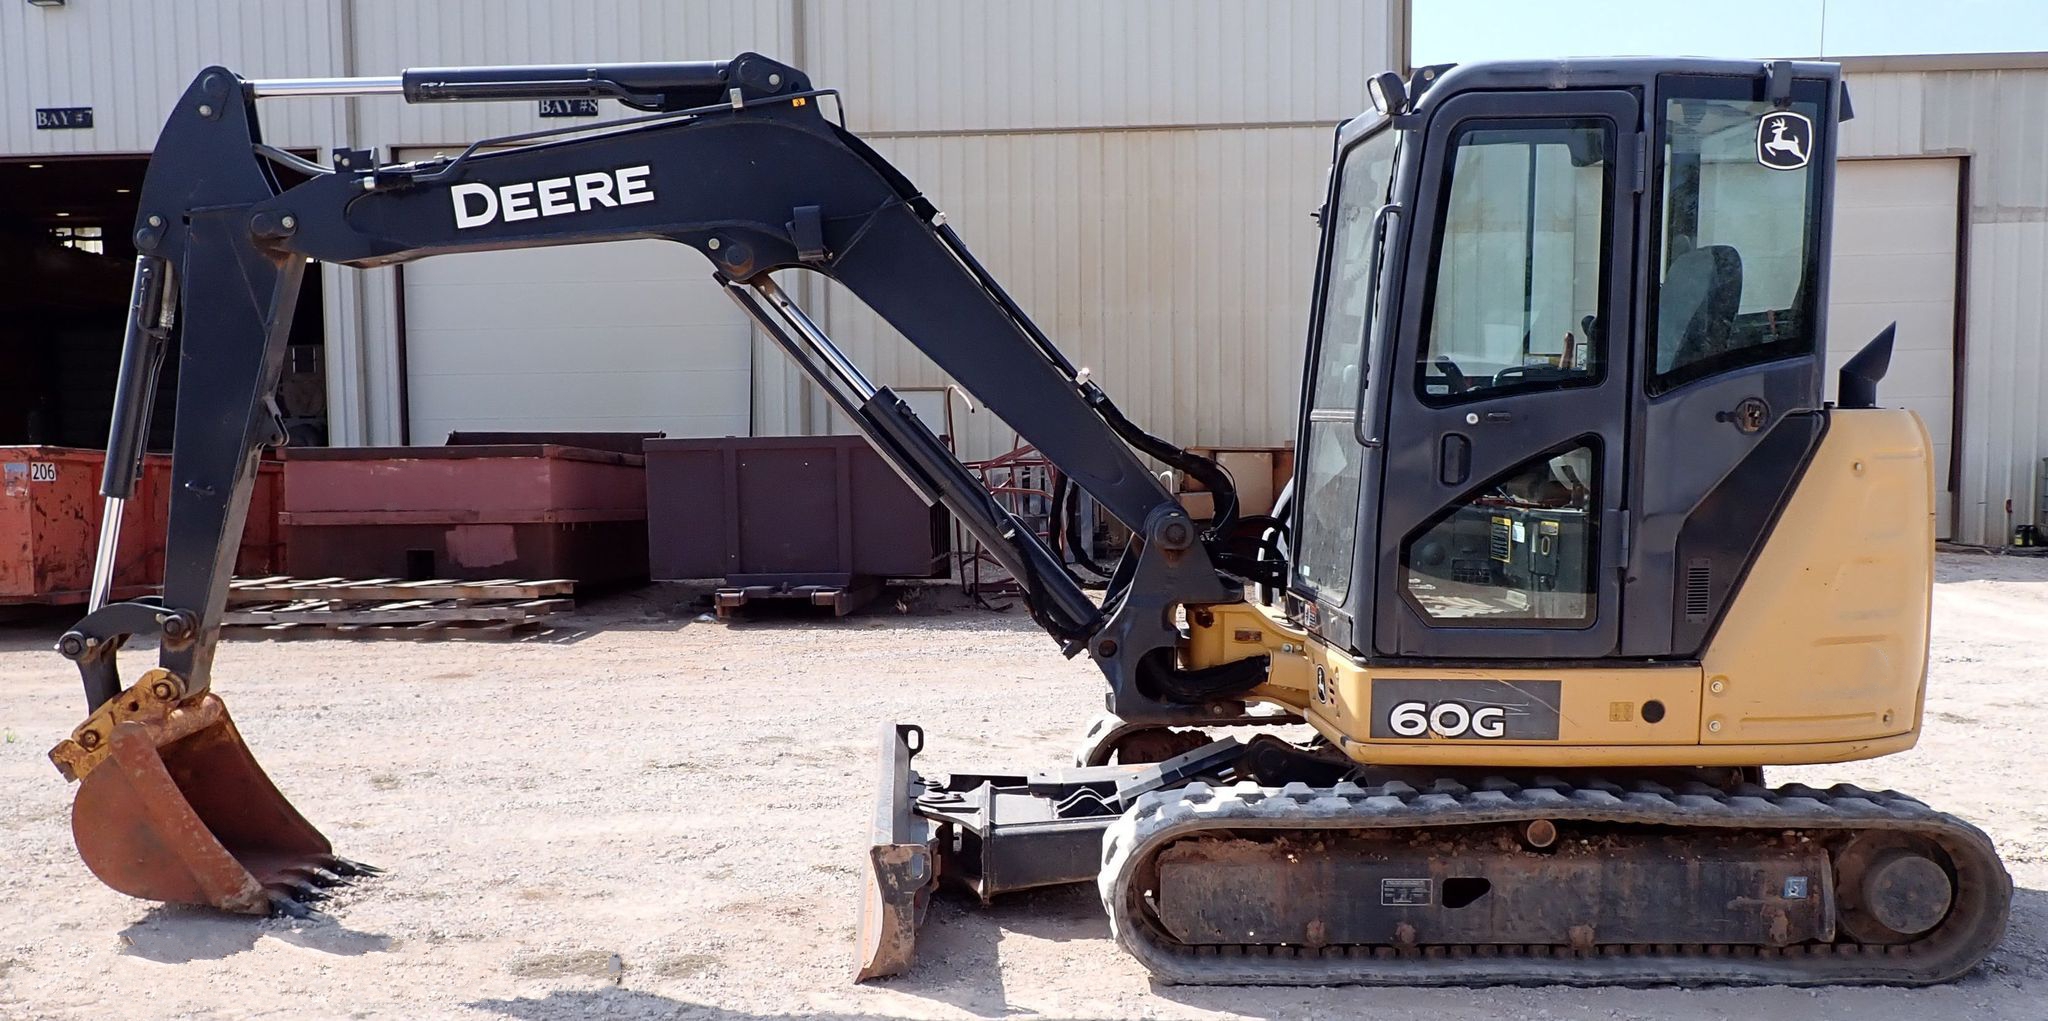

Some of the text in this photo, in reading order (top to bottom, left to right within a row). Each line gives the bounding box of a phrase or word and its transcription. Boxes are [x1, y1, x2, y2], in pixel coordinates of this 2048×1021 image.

[540, 99, 598, 114] BAY #8
[37, 111, 71, 126] BAY
[450, 165, 655, 229] DEERE
[32, 463, 55, 480] 206
[1389, 701, 1505, 738] 60G
